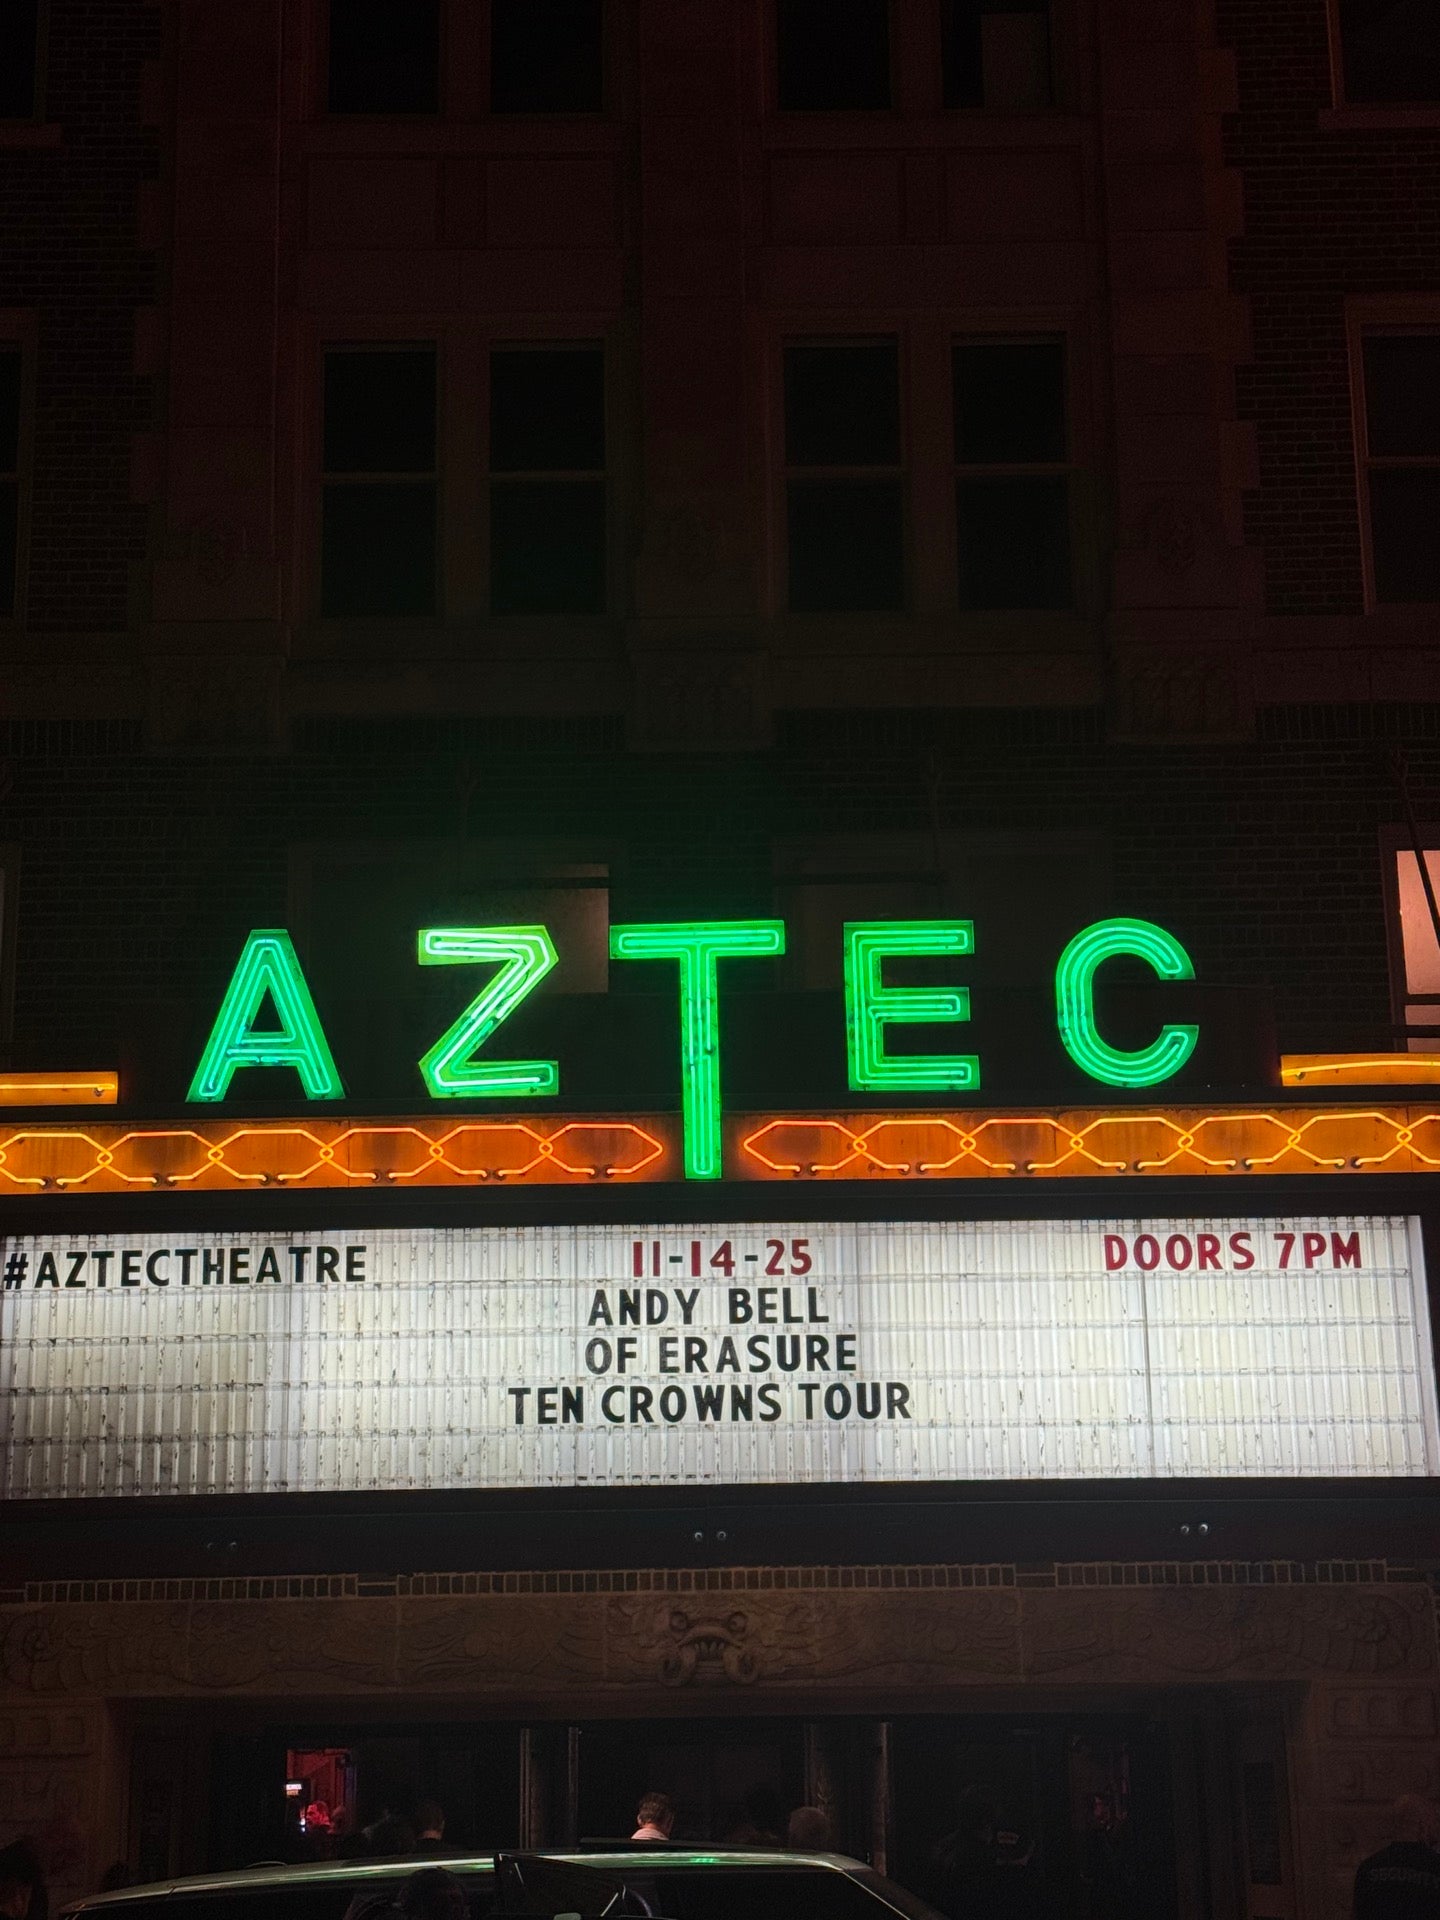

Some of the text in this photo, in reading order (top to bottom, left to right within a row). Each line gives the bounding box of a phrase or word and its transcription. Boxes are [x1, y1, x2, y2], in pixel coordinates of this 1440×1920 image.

[186, 917, 1200, 1180] AZTEC
[4, 1246, 367, 1290] #AZTECTHEATRE
[633, 1239, 813, 1277] 11-14-25
[1104, 1231, 1362, 1271] DOORS 7PM
[587, 1286, 830, 1326] ANDY BELL
[585, 1334, 857, 1374] OF ERASURE
[508, 1382, 912, 1425] TEN CROWNS TOUR
